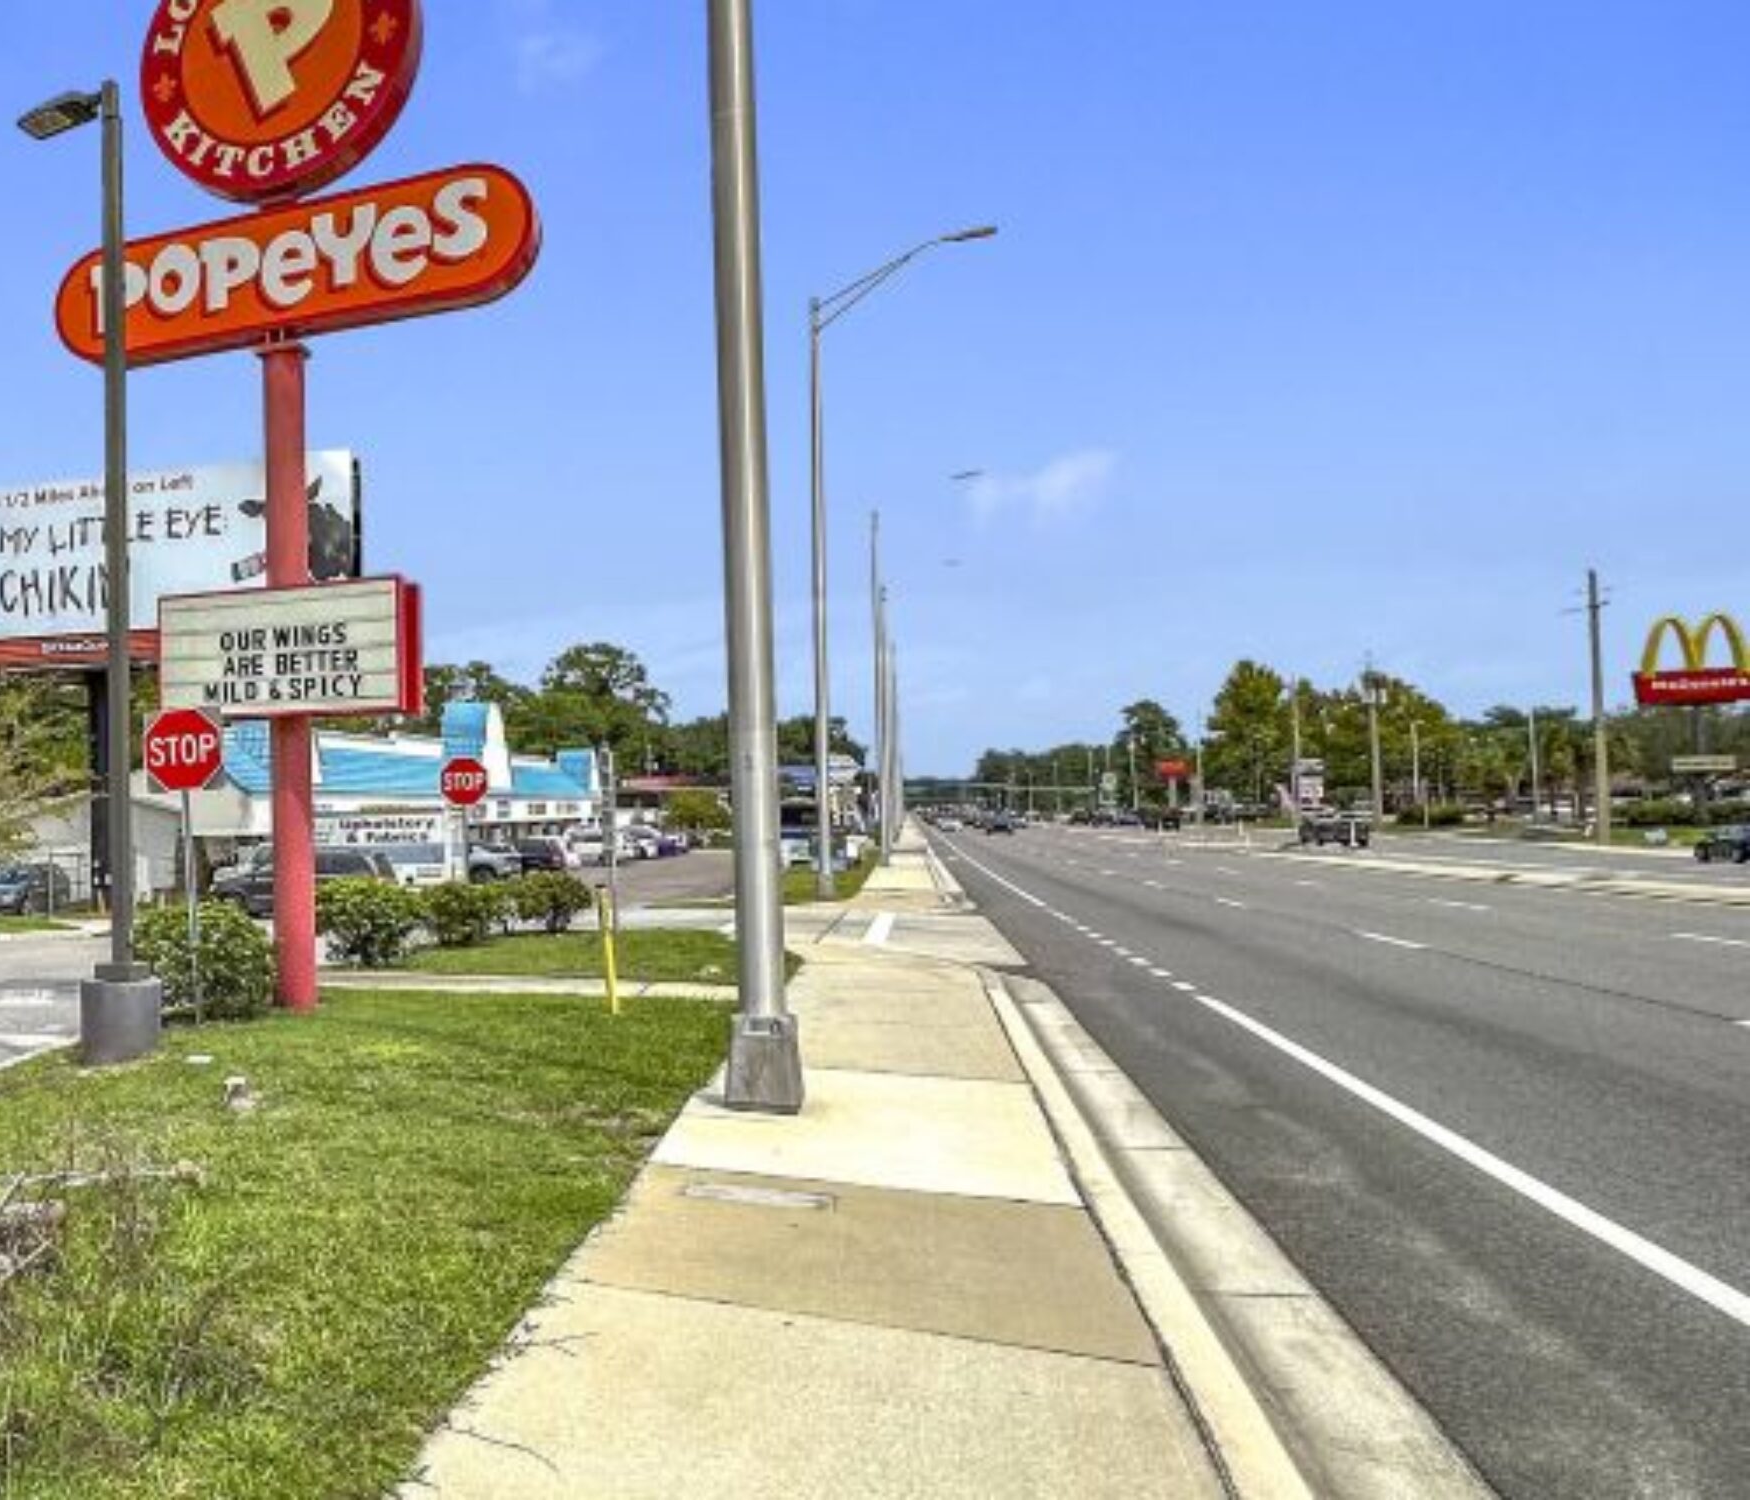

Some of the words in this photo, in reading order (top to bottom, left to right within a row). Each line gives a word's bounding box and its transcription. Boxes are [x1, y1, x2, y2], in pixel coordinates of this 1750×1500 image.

[162, 61, 385, 177] KITCHEN
[0, 524, 40, 555] MY
[48, 509, 155, 556] LITTE
[219, 629, 266, 652] OUR
[273, 621, 347, 648] WINGS
[223, 654, 264, 677] ARE
[275, 649, 359, 676] BETTER
[204, 680, 257, 703] MILD
[269, 679, 281, 699] &
[289, 673, 362, 700] SPICY
[150, 732, 216, 767] STOP
[443, 771, 484, 792] STOP
